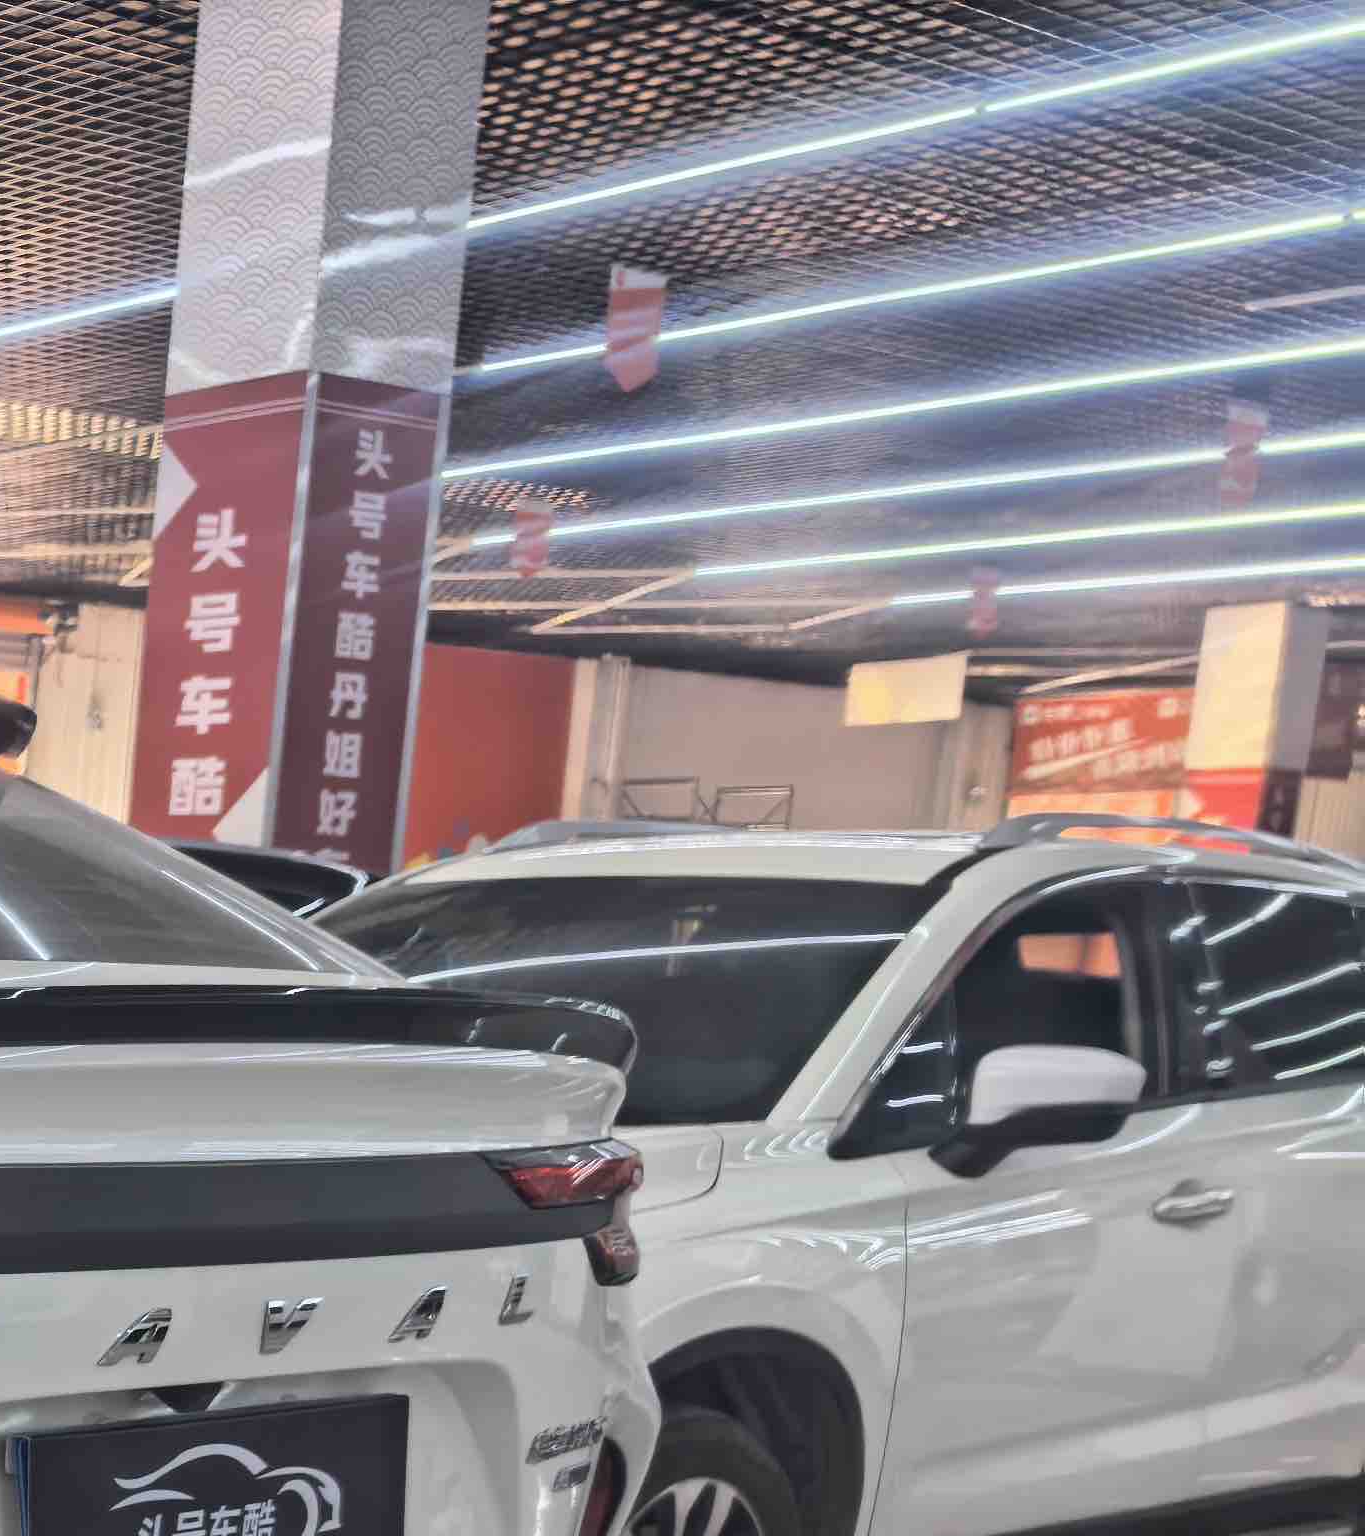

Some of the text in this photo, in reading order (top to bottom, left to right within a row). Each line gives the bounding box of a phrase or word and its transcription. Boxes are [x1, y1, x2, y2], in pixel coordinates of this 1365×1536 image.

[167, 507, 248, 817] 头号车酷
[314, 428, 393, 866] 头号车酷丹姐好
